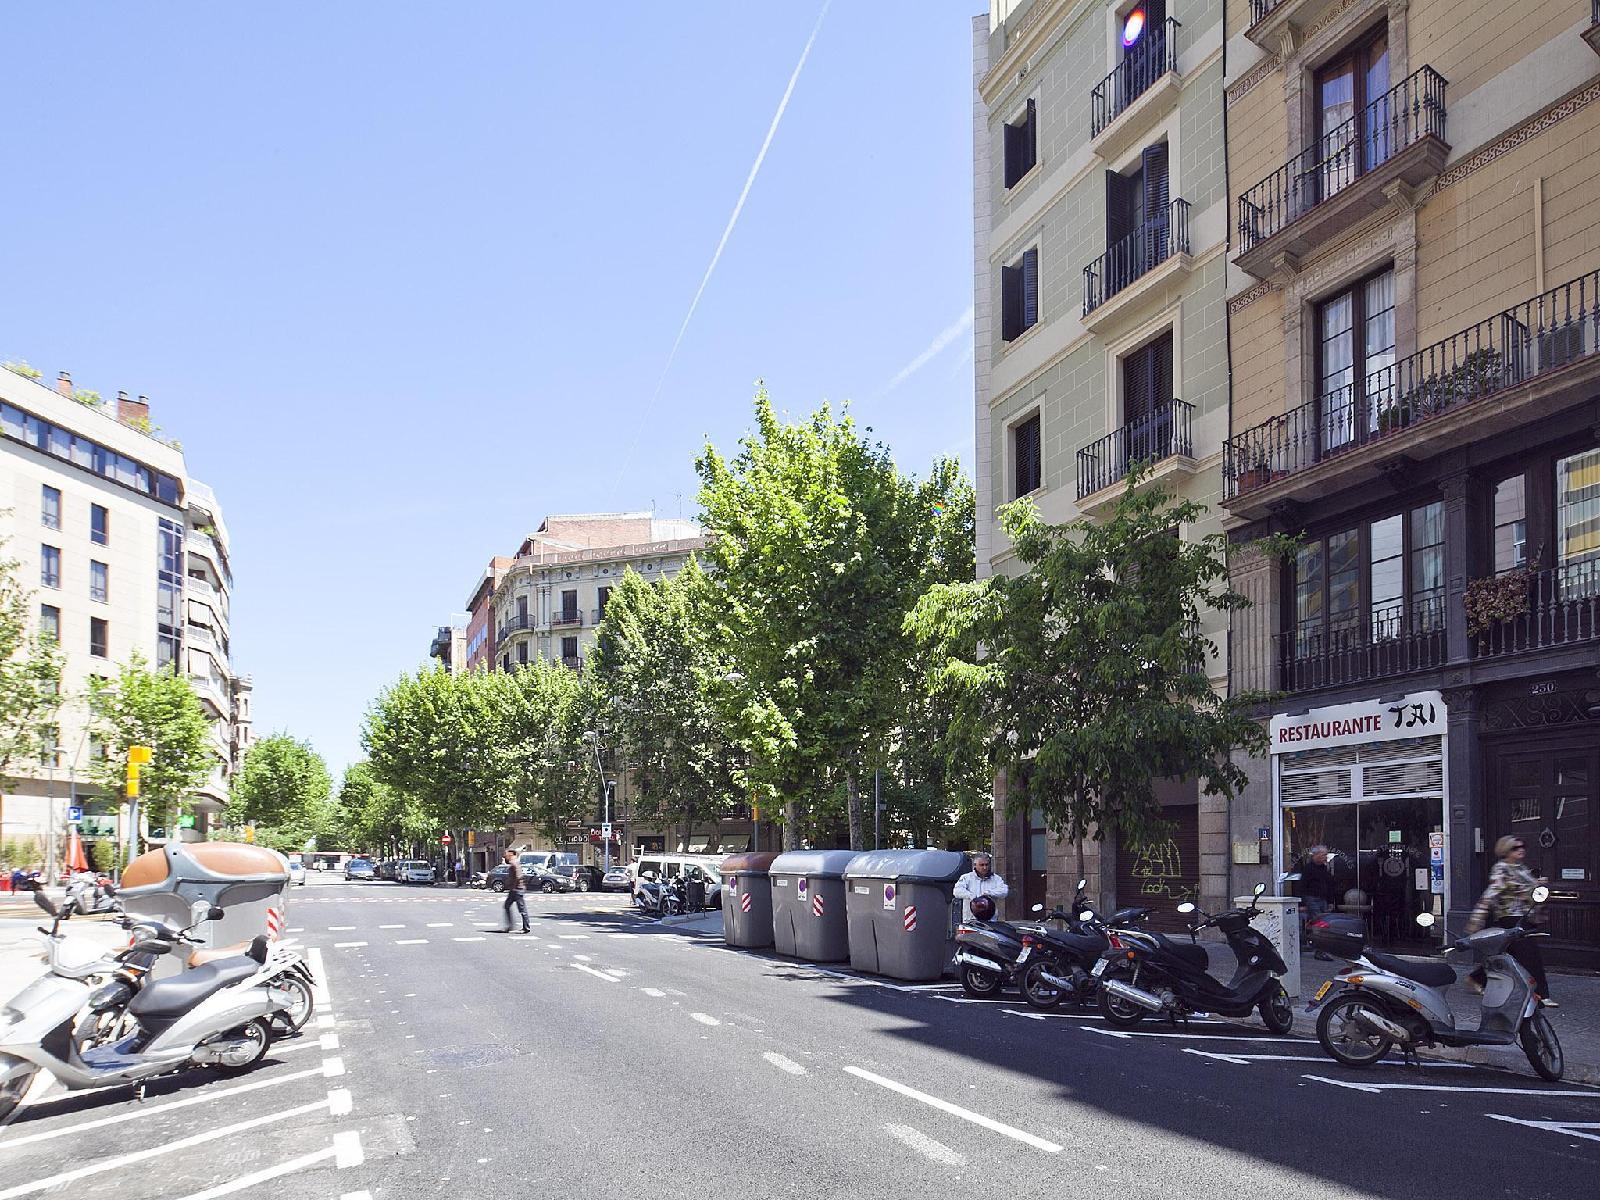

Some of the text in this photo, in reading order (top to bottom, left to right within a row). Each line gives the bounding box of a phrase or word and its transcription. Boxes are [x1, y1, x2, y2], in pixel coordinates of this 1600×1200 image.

[1531, 683, 1555, 694] 250
[1279, 702, 1435, 743] RESTAURANTE TAI
